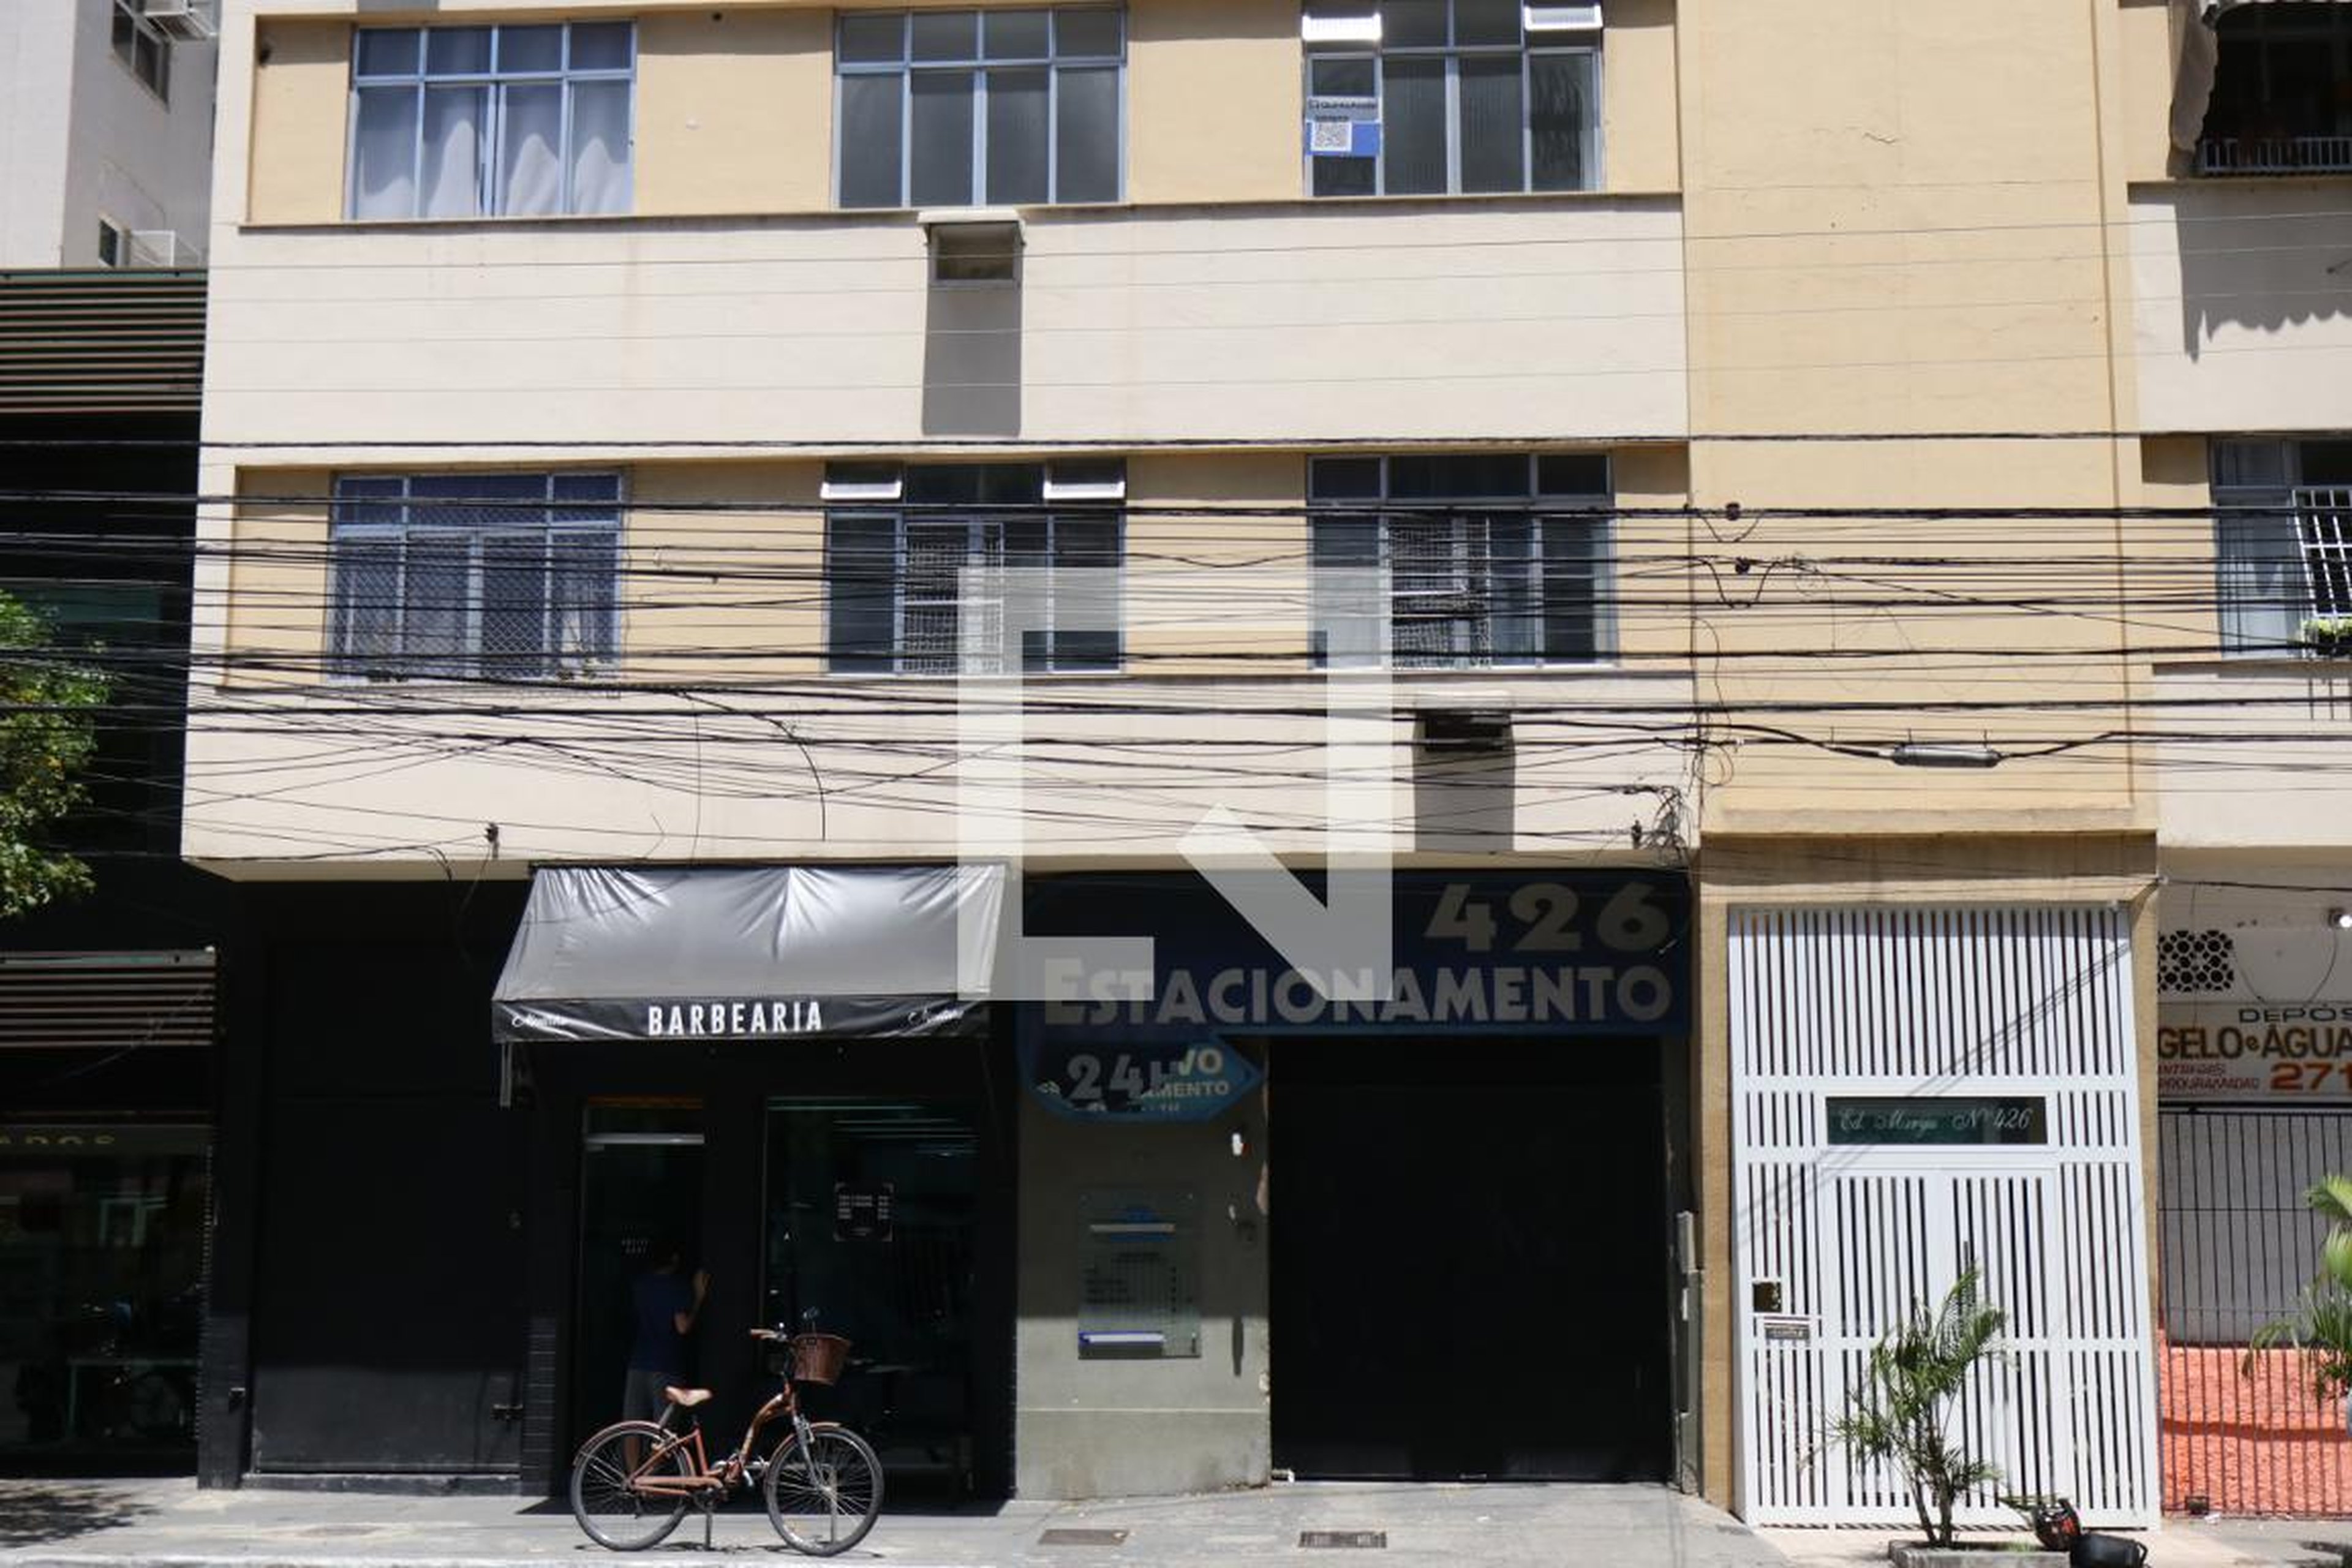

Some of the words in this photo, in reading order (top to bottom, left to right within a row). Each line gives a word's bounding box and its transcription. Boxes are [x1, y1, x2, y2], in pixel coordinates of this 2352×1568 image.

[1423, 882, 1670, 952] 426
[1045, 957, 1672, 1025] ESTACIONAMENTO
[649, 1001, 822, 1036] BARBEARIA
[2158, 1027, 2243, 1059] GELO
[2246, 1035, 2260, 1051] e
[1993, 1107, 2034, 1131] 426
